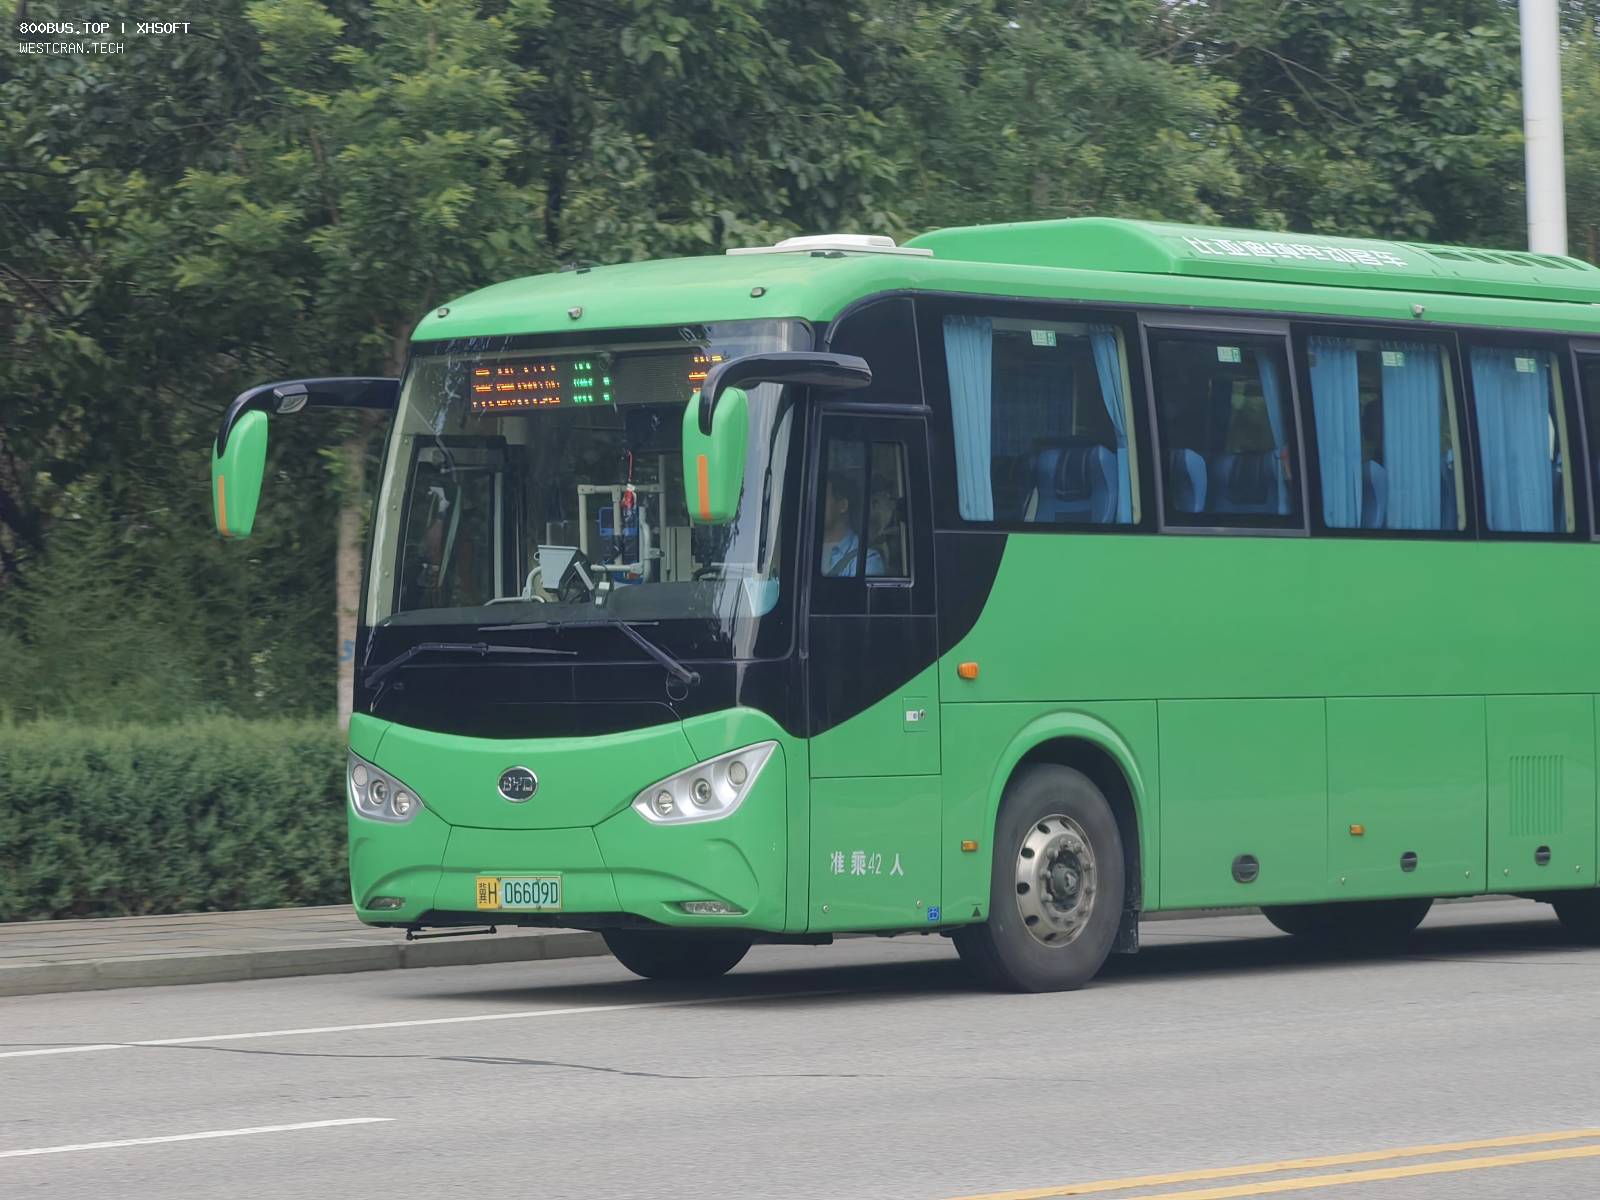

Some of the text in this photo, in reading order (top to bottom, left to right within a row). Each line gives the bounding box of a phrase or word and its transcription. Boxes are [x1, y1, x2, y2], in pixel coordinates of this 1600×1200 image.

[1182, 236, 1408, 267] 比亚迪纯电动客车
[502, 776, 533, 792] BYD
